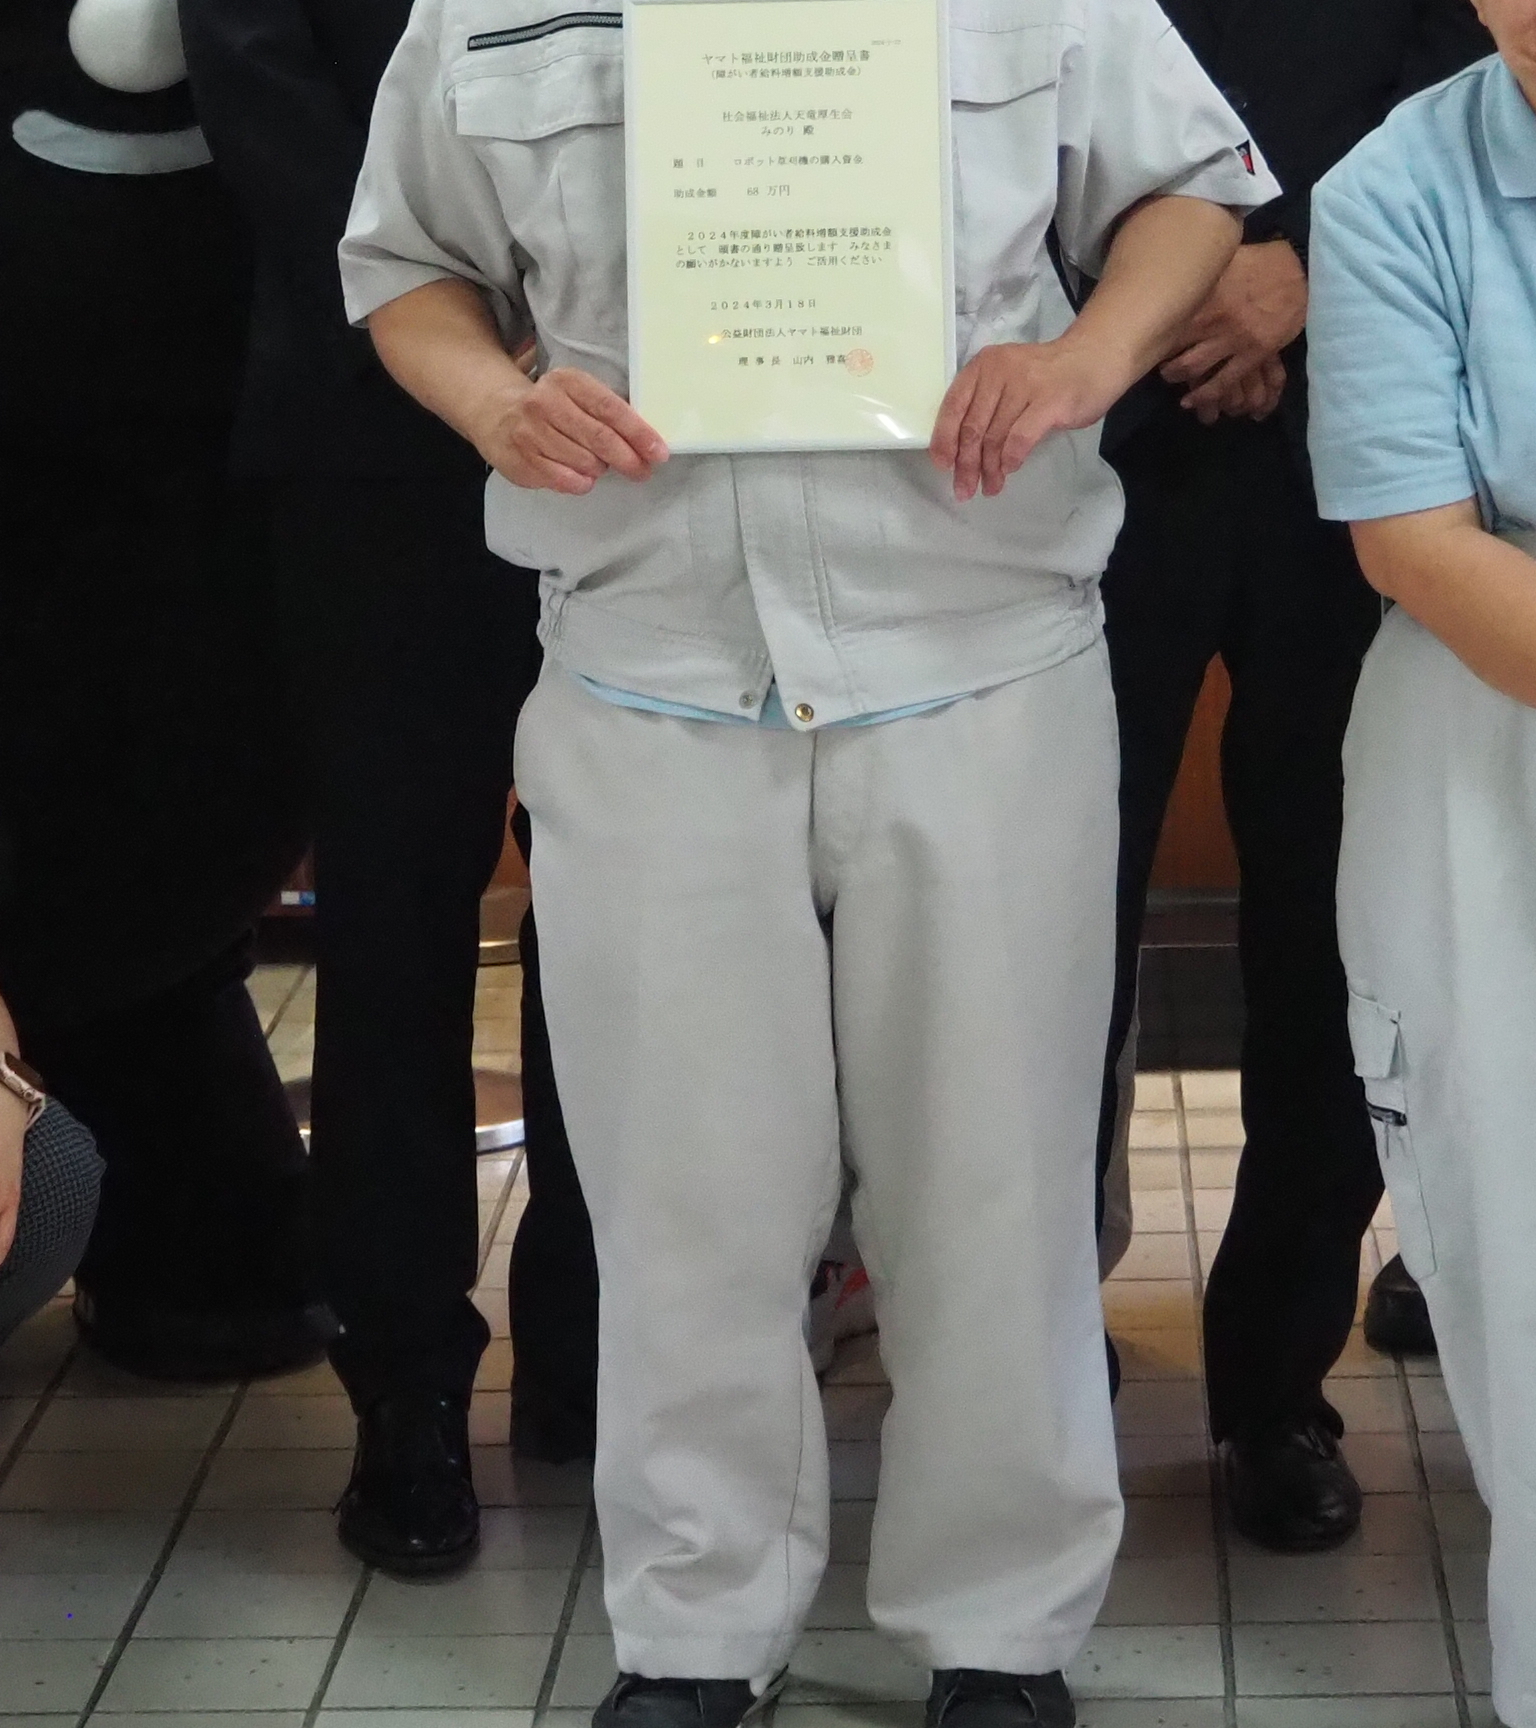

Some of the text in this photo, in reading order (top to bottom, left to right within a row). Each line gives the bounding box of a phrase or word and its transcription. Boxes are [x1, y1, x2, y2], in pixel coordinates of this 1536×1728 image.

[701, 49, 871, 66] ヤマト福祉財団助成金贈呈書
[722, 108, 853, 122] 社会福祉法人天竜厚生会
[673, 187, 718, 199] 助成金額
[676, 244, 707, 256] として
[848, 240, 892, 252] みなさま
[806, 254, 883, 267] ご活用ください
[710, 298, 816, 311] 2024年3月18日
[721, 325, 863, 339] 公益財団法人ヤマト福祉財団
